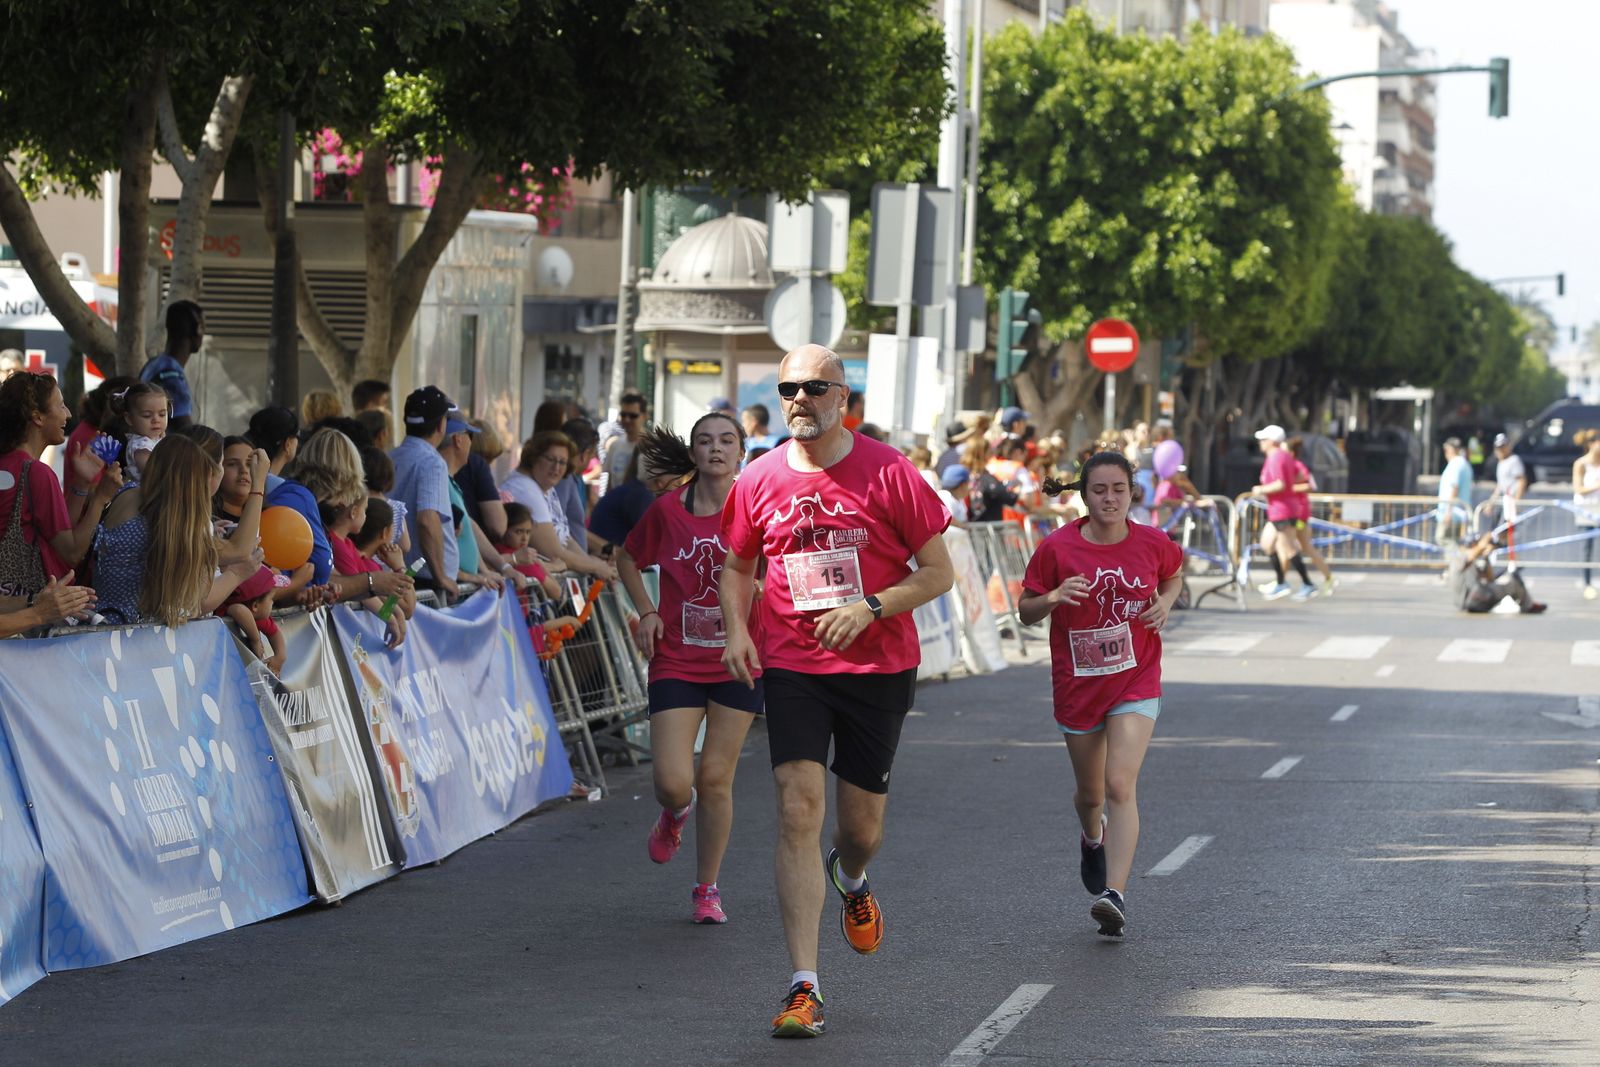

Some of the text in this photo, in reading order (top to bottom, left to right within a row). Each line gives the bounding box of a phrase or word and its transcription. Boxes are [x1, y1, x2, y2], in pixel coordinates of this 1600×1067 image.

[834, 527, 868, 537] CARRERA
[821, 566, 845, 586] 15
[1099, 637, 1126, 657] 107
[133, 772, 187, 814] CARRERA
[146, 807, 199, 848] SOLIDARIA
